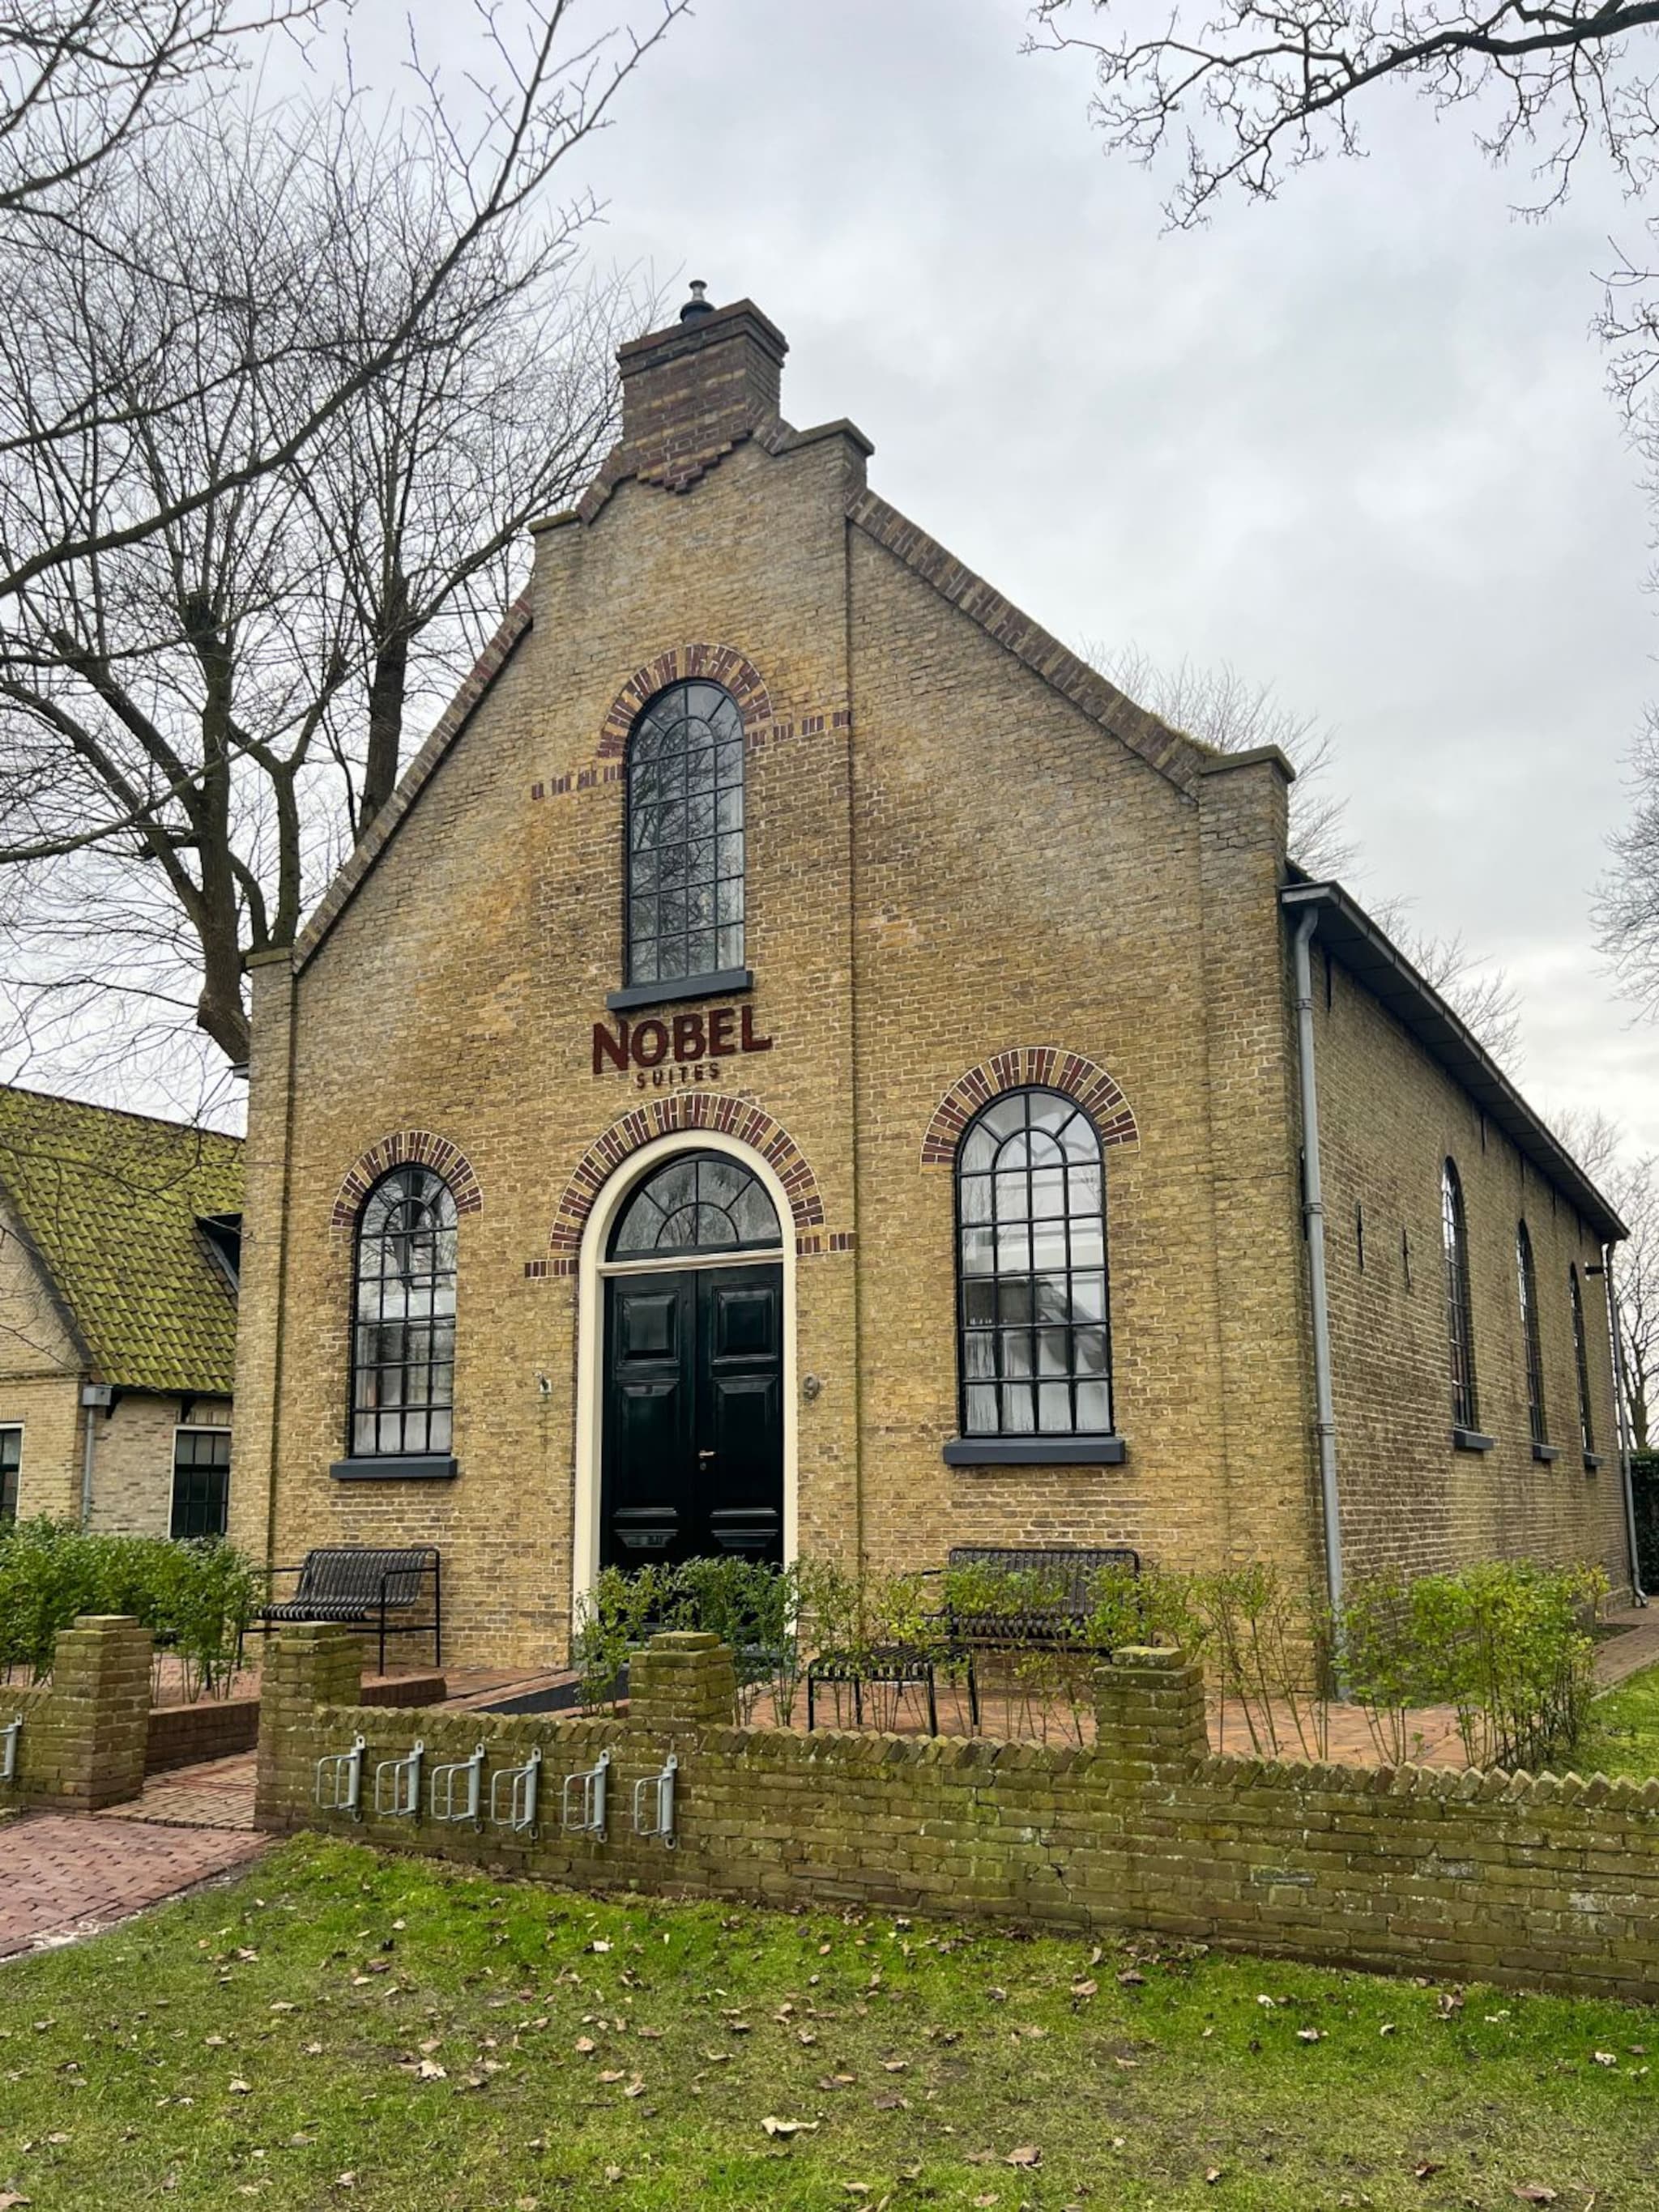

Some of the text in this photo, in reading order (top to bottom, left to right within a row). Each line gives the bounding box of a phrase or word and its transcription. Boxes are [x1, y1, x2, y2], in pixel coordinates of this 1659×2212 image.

[593, 1004, 773, 1075] NOBEL
[636, 1062, 720, 1089] SUITES
[803, 1373, 820, 1400] 9
